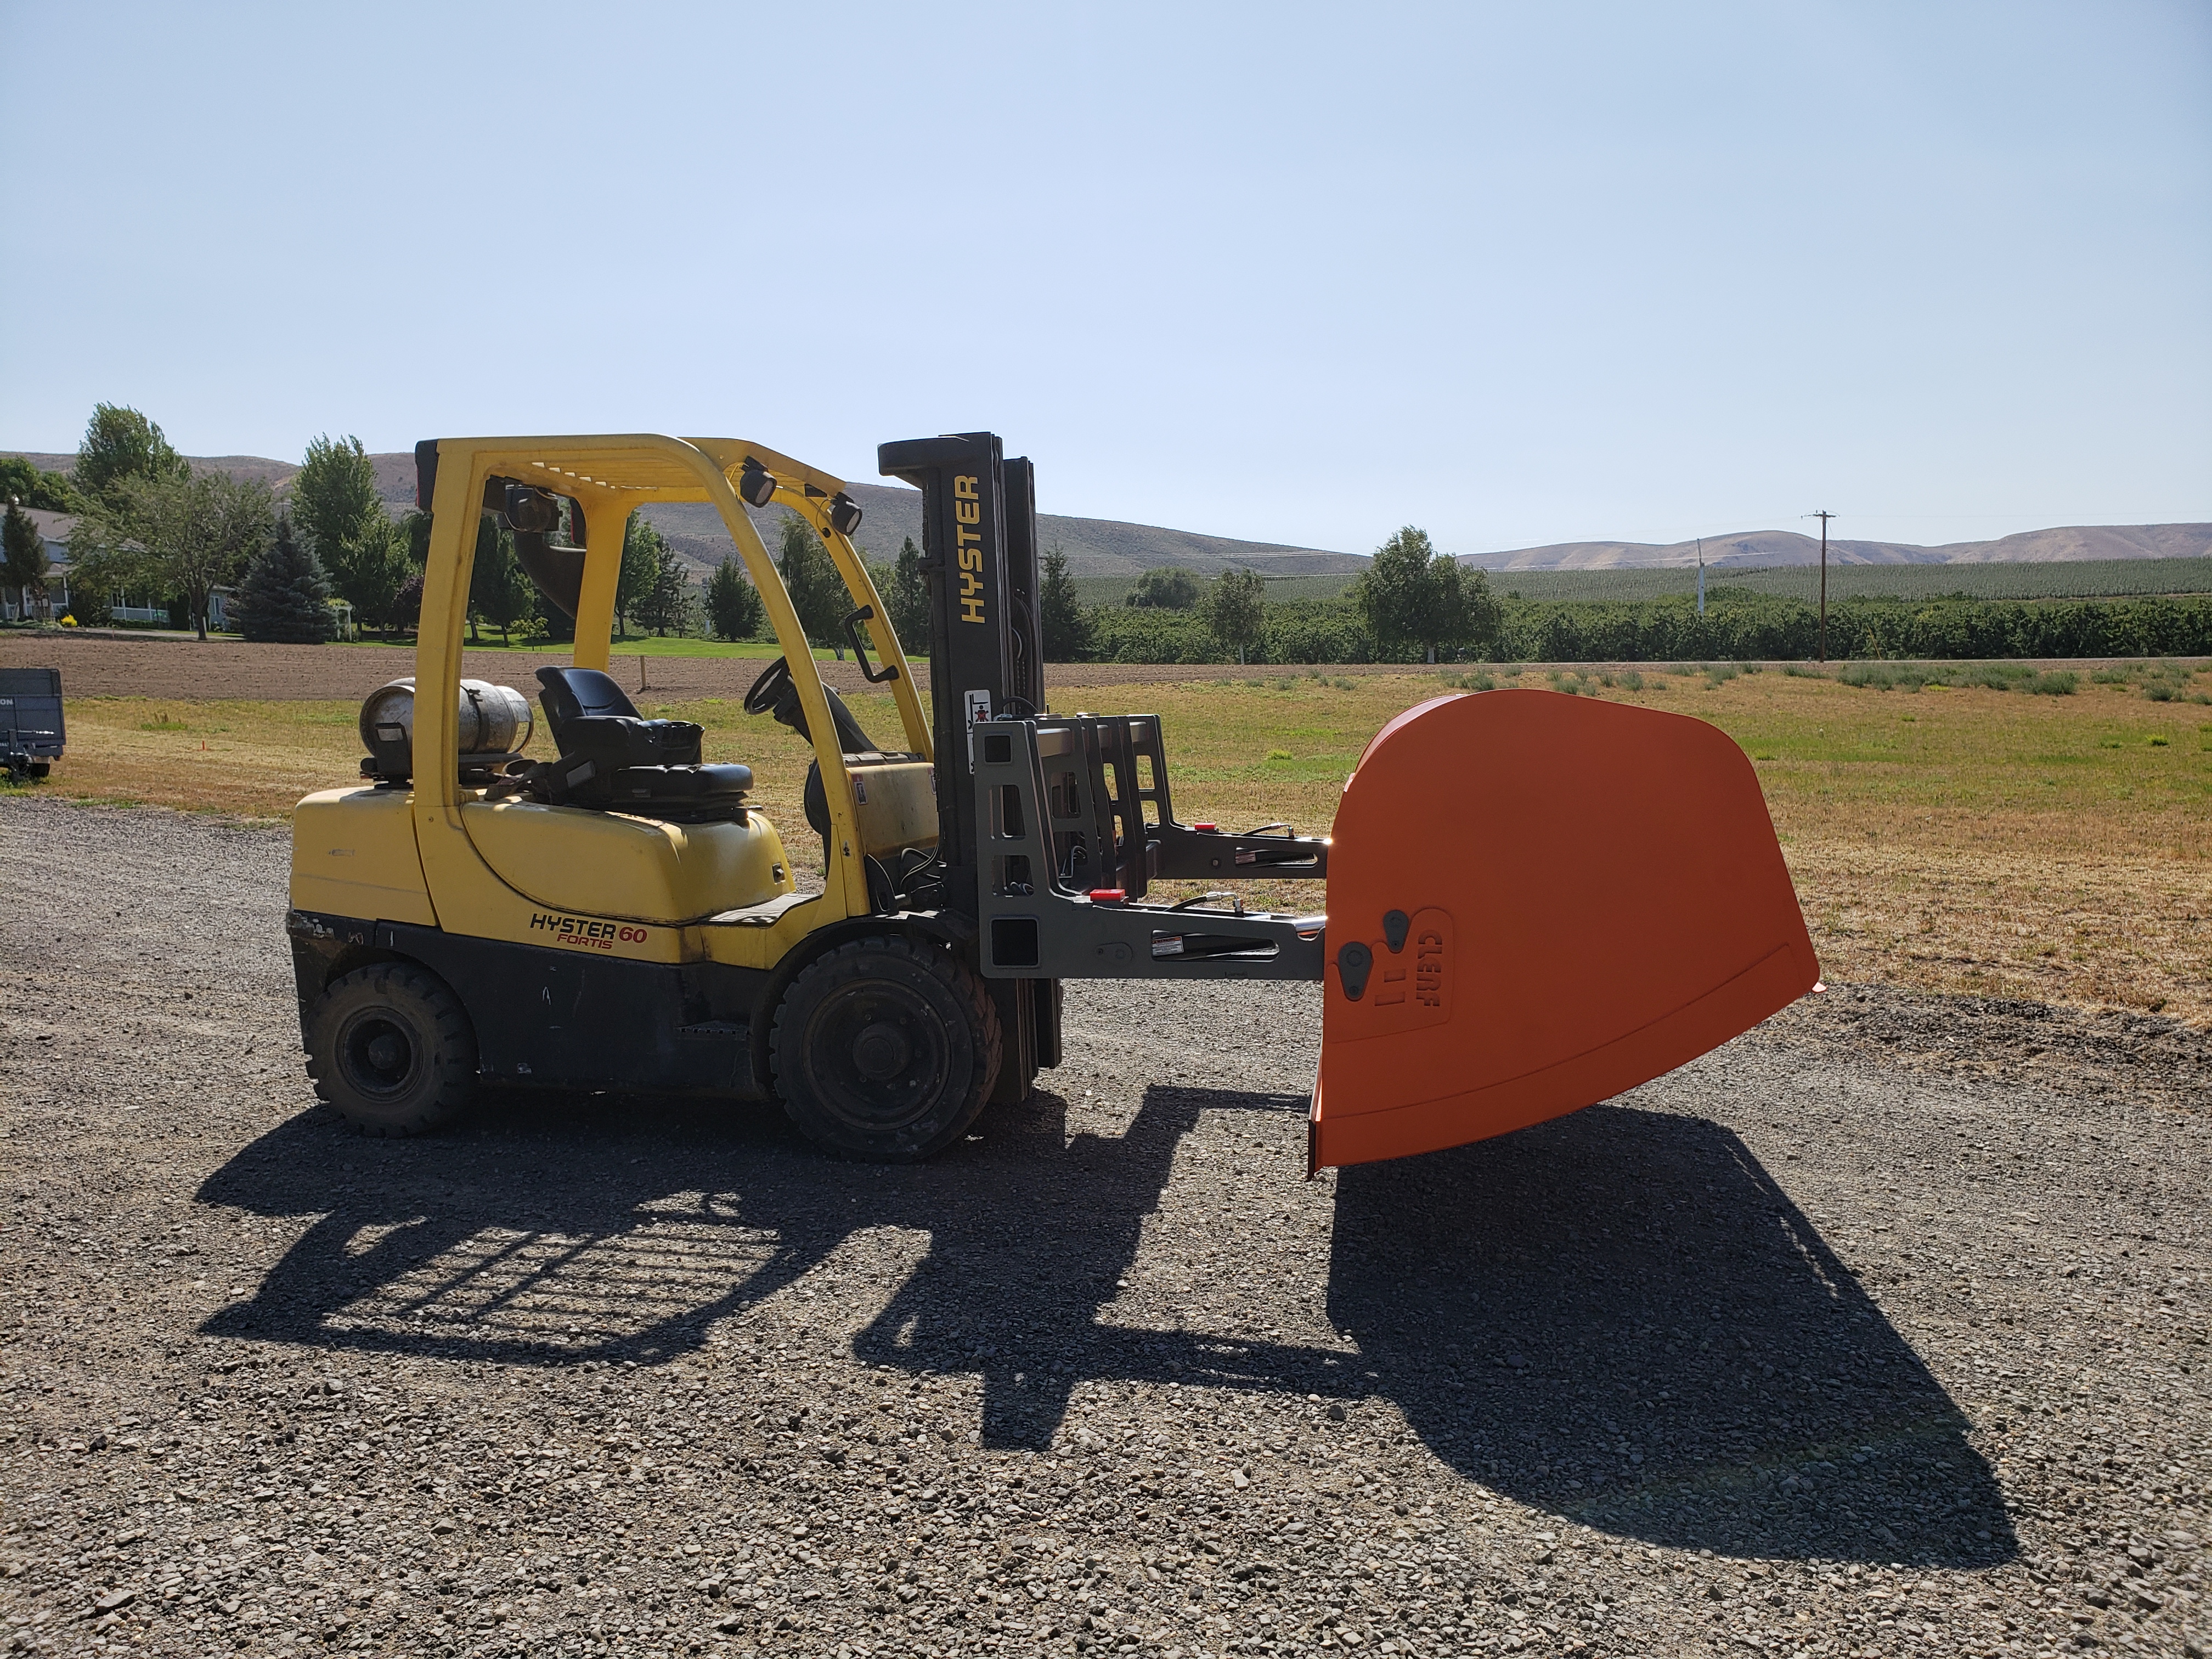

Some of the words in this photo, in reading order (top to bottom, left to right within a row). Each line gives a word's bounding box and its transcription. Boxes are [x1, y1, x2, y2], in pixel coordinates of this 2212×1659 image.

[955, 475, 985, 624] HYSTER
[530, 913, 617, 940] HYSTER
[619, 927, 647, 944] 60
[557, 934, 613, 949] FORTIS
[1416, 930, 1443, 1007] CLERF
